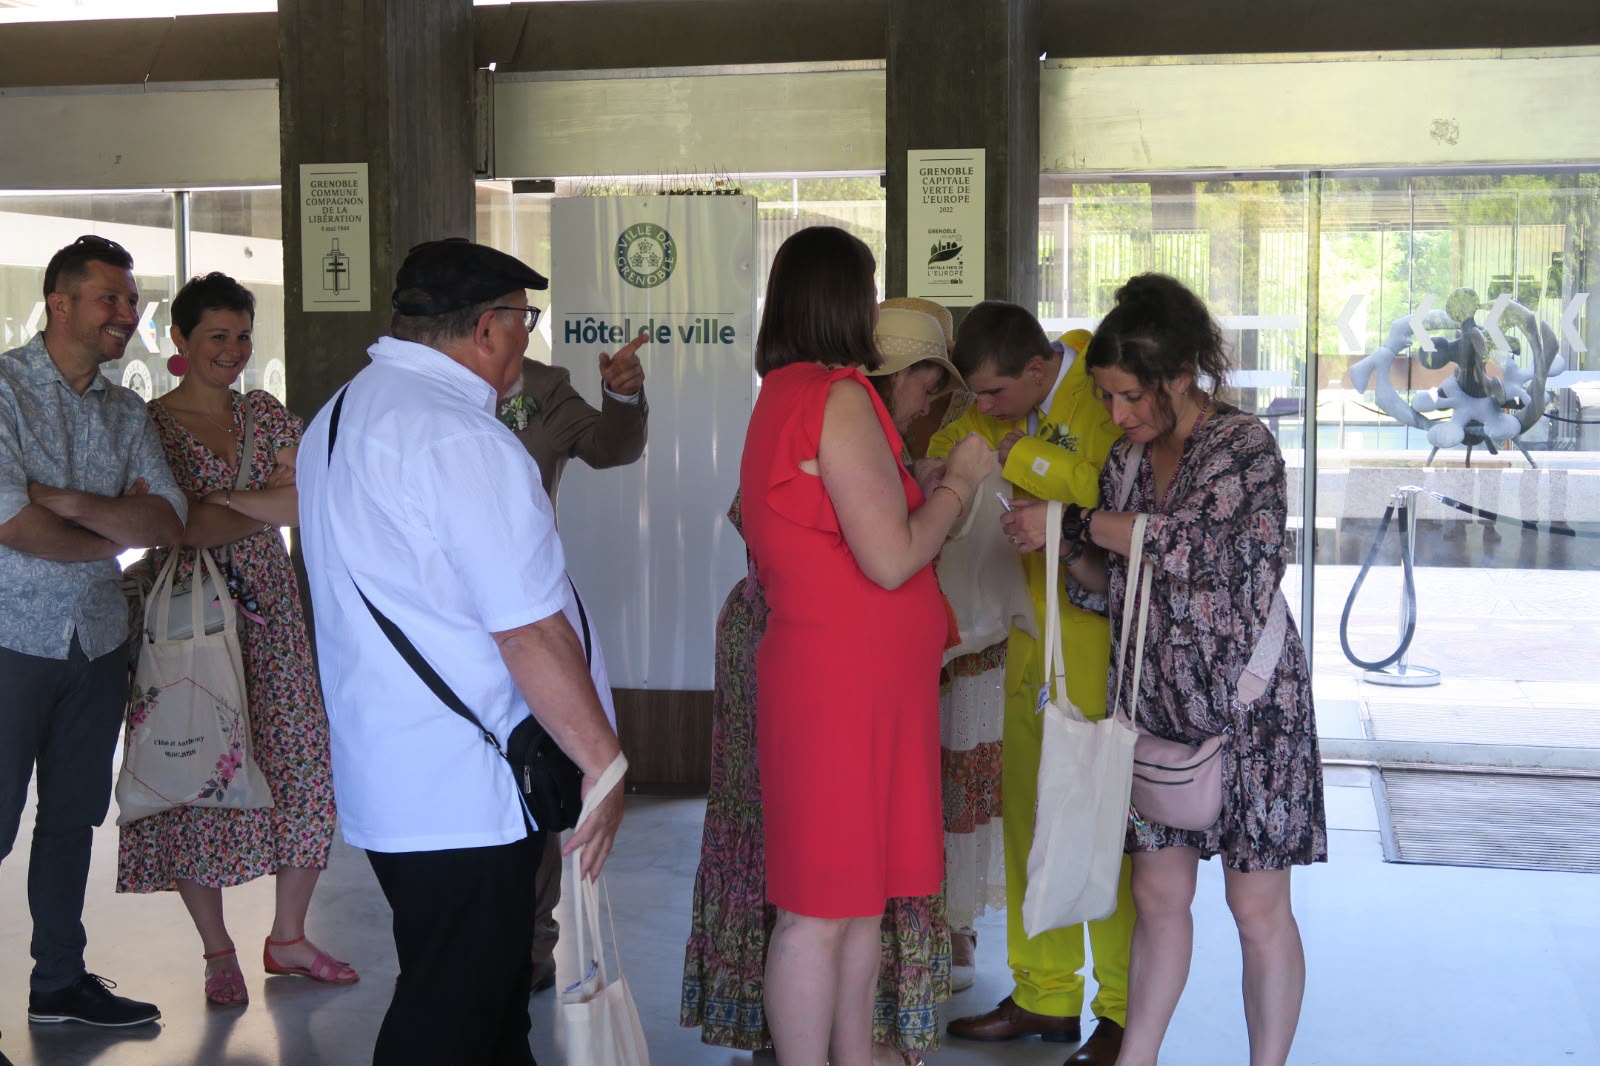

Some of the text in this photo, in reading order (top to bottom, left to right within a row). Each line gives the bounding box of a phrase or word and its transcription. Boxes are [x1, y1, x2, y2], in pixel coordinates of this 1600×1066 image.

[919, 167, 974, 176] GRENOBLE
[310, 180, 358, 188] GRENOBLE
[922, 176, 971, 185] CAPITALE
[311, 189, 358, 197] COMMUNE
[922, 185, 971, 194] VERTE DE
[305, 197, 364, 206] COMPAGNON
[923, 195, 970, 204] L'EUROPE
[322, 206, 348, 214] DE LA
[308, 213, 362, 223] LIBÉRATION
[618, 225, 672, 250] VILLE DE
[617, 256, 674, 286] GRENOBLE
[564, 317, 736, 345] Hôtel de ville
